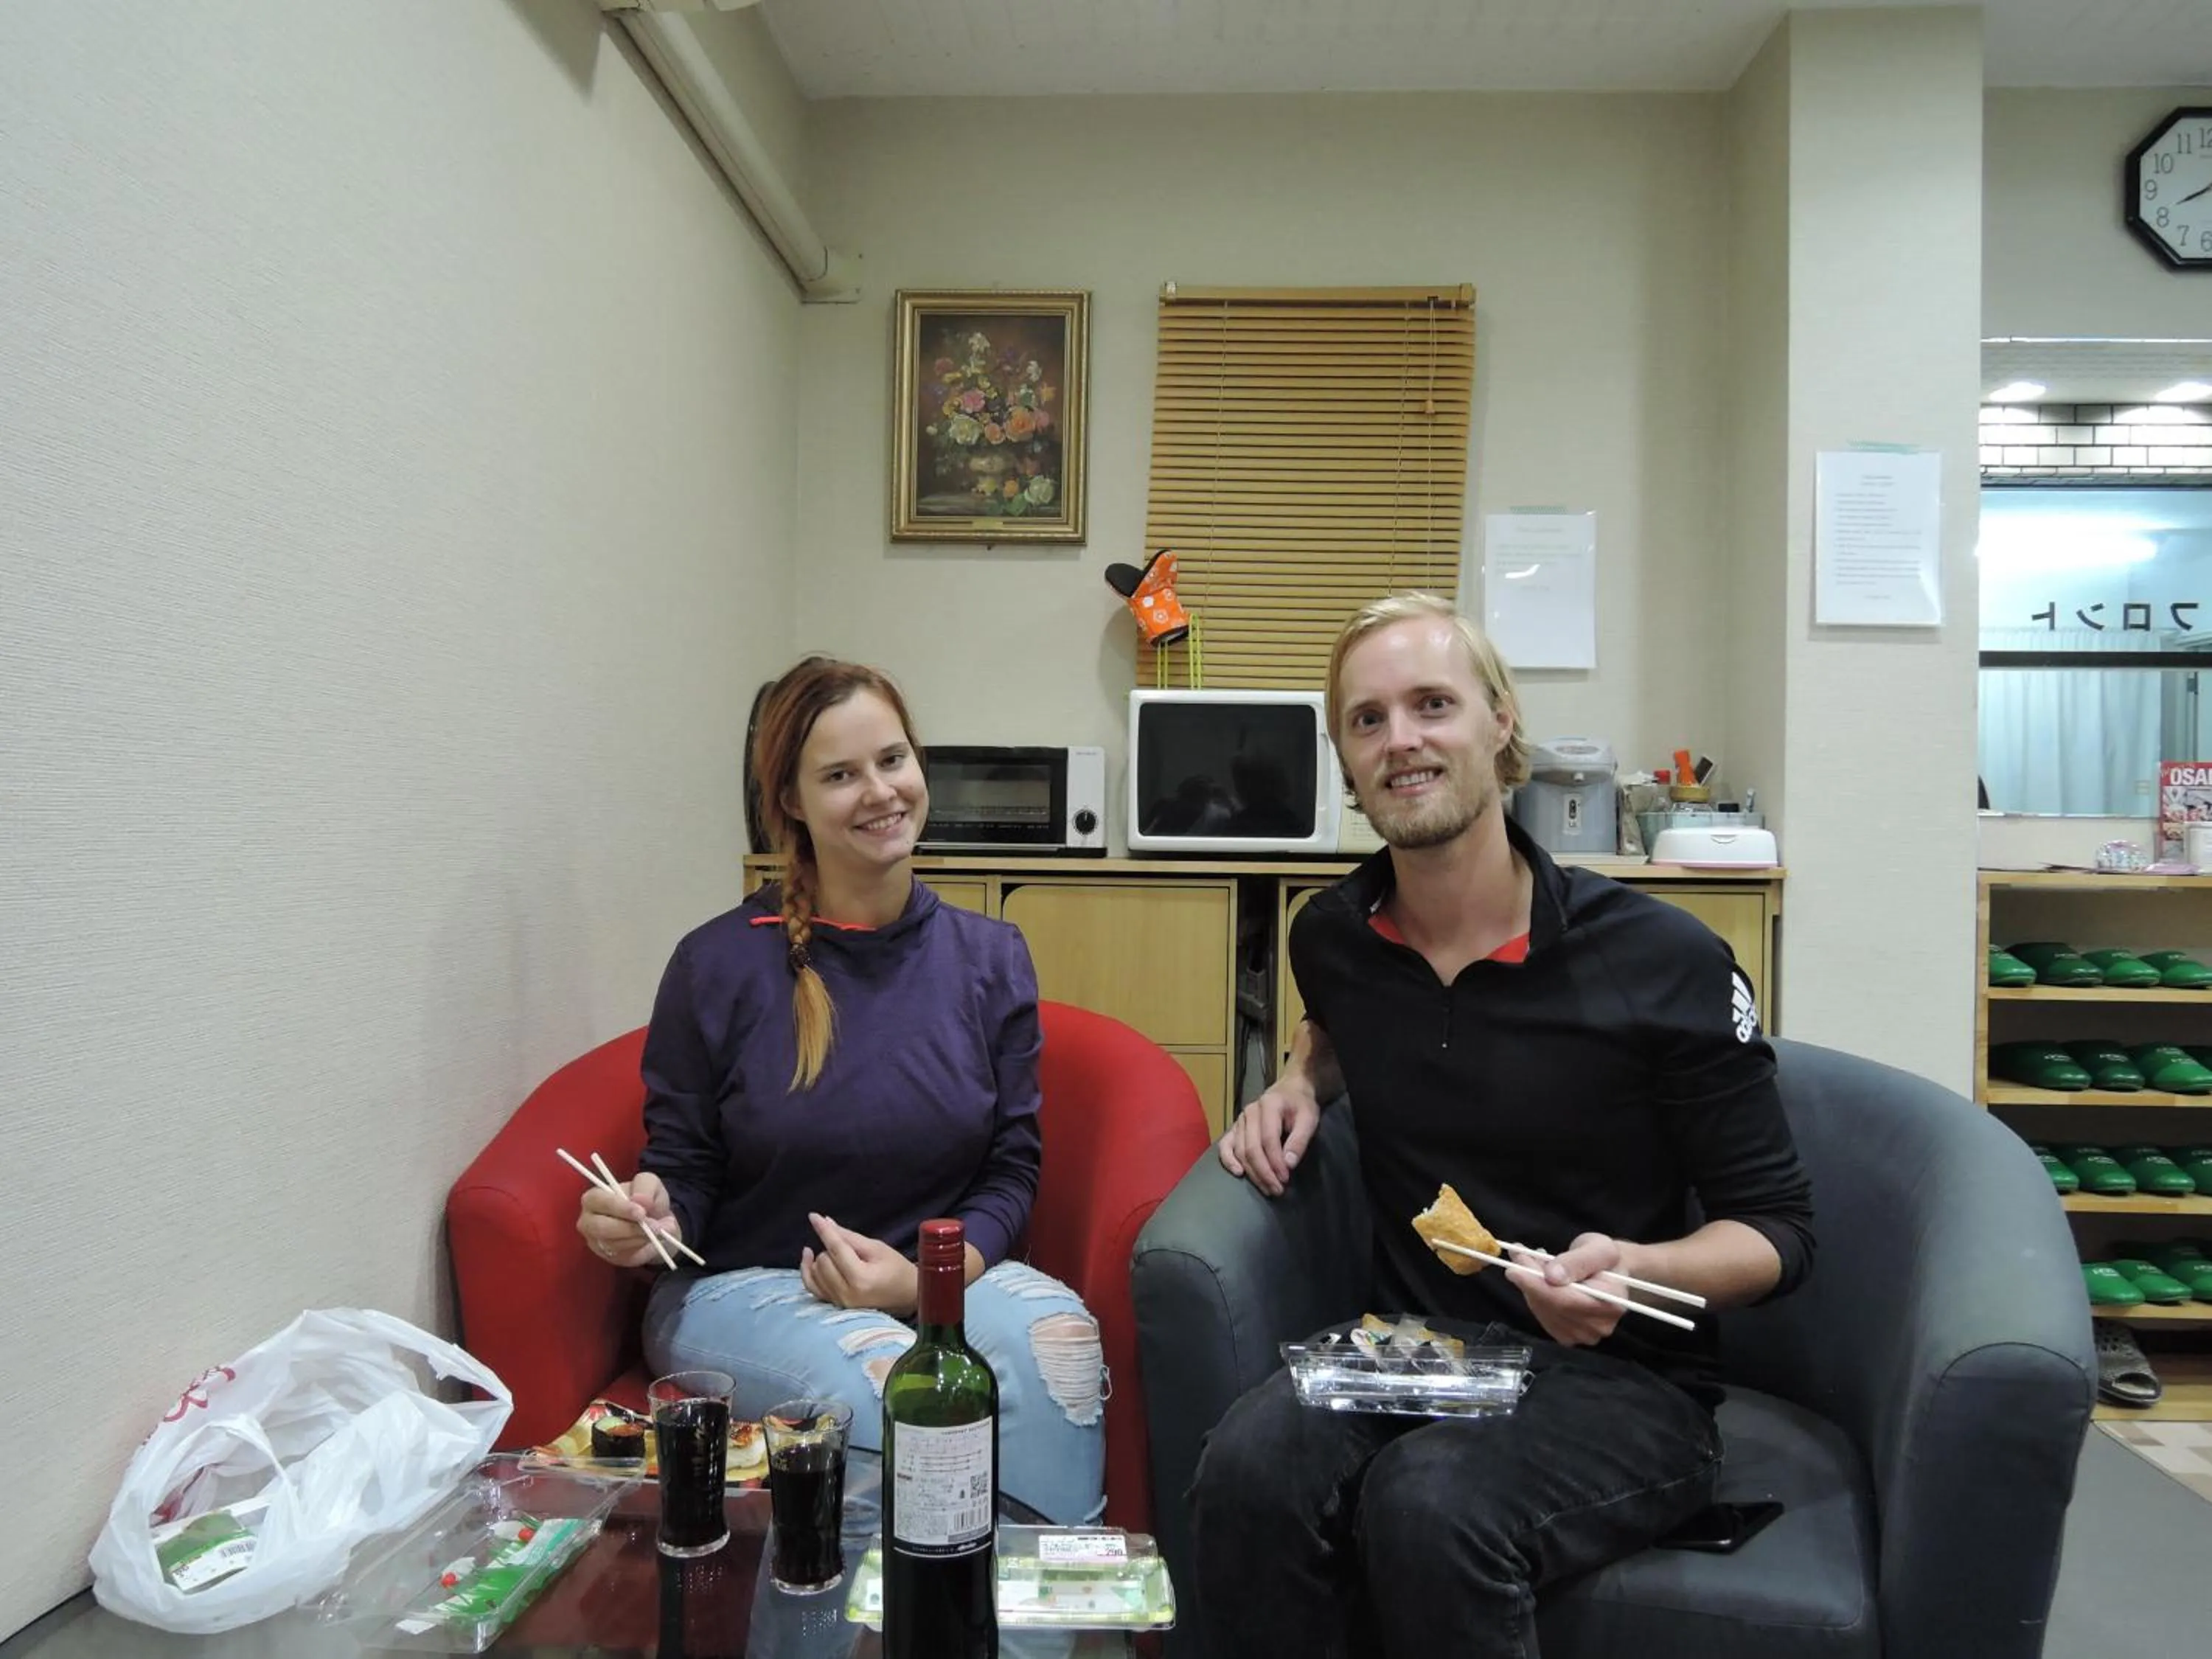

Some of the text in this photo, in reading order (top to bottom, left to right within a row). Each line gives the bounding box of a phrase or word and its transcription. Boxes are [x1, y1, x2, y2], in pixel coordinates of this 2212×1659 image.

[2177, 133, 2192, 154] 11
[2154, 153, 2174, 174] 10
[2144, 179, 2157, 201] 9
[2156, 206, 2170, 228] 8
[2177, 224, 2190, 246] 7
[2201, 231, 2212, 252] 6
[2170, 767, 2212, 786] OSA
